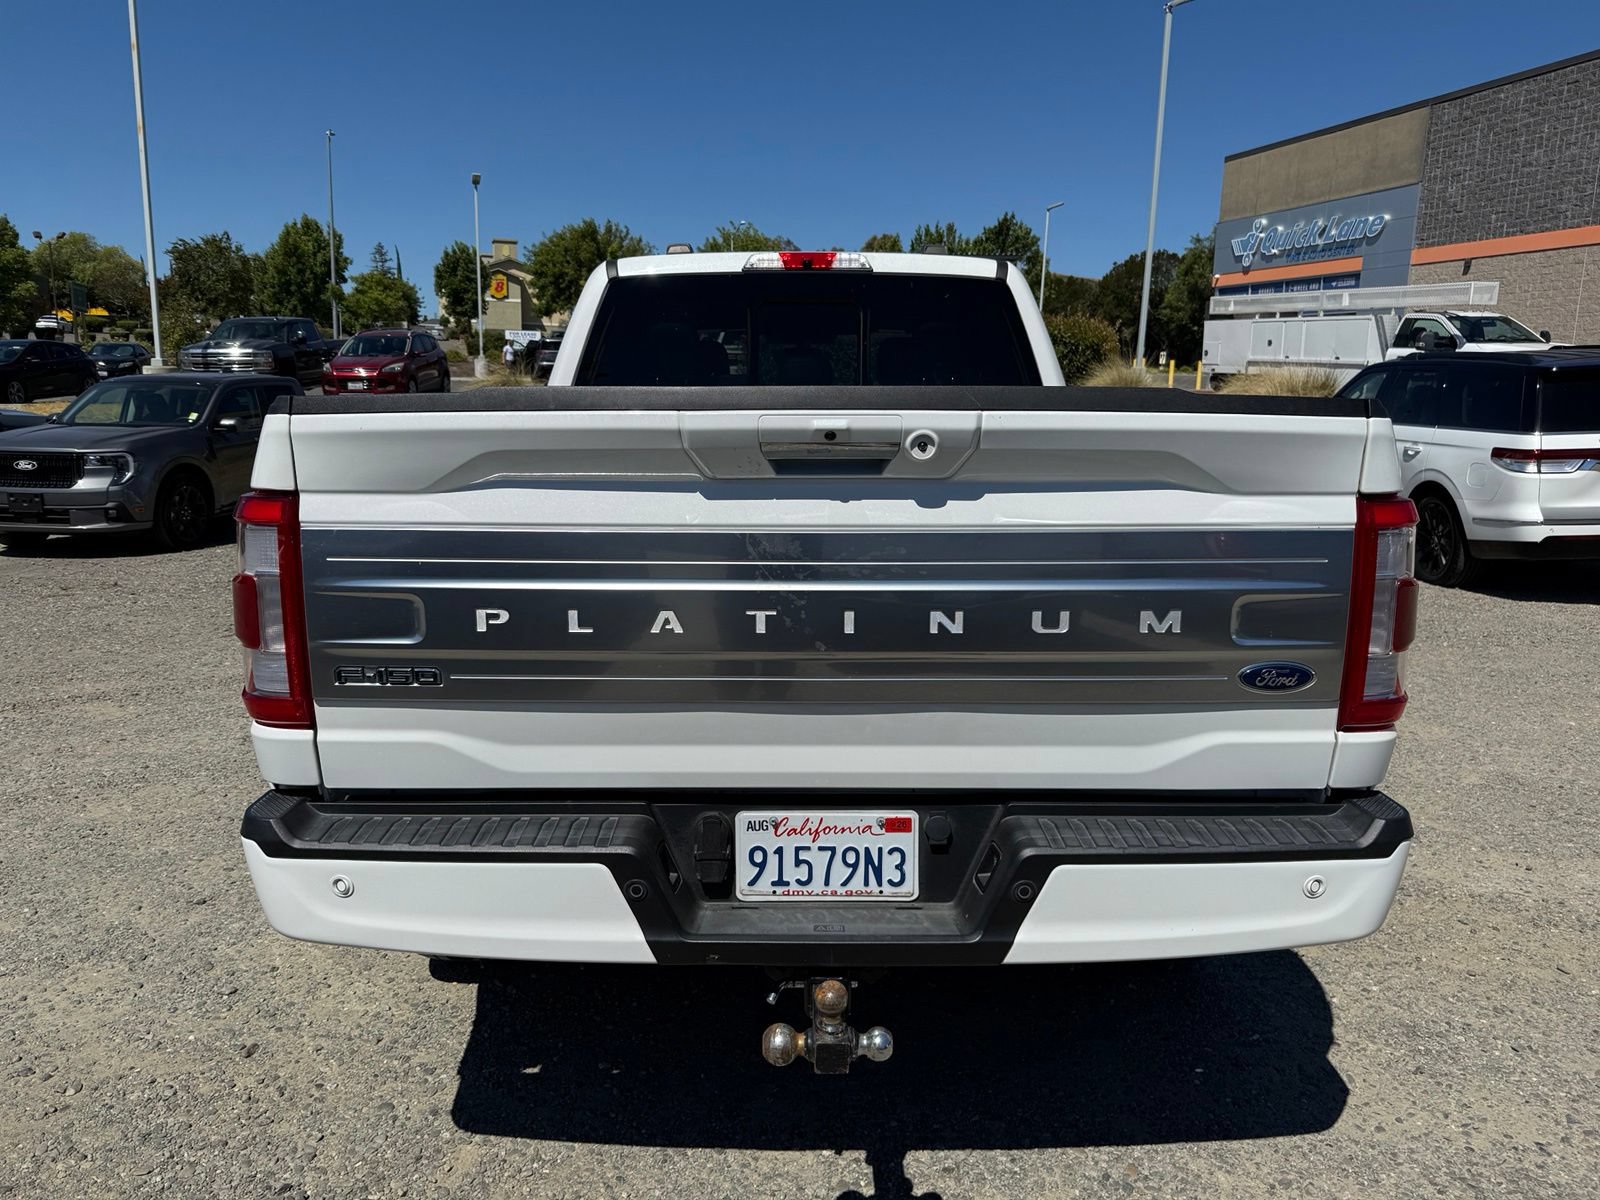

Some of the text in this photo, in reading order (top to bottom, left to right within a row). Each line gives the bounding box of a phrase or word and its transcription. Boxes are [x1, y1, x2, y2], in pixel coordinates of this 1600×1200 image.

[1261, 215, 1385, 255] Quick Lane
[1307, 248, 1326, 259] AUTO
[1328, 245, 1356, 257] CENTER
[494, 281, 504, 293] 8
[476, 609, 1182, 634] PLATINUM
[334, 665, 443, 687] F-150
[1255, 668, 1299, 687] Ford
[746, 819, 769, 832] AUG
[774, 816, 885, 843] California
[747, 845, 907, 887] 91579N3
[781, 888, 874, 897] dmv.ca.gov
